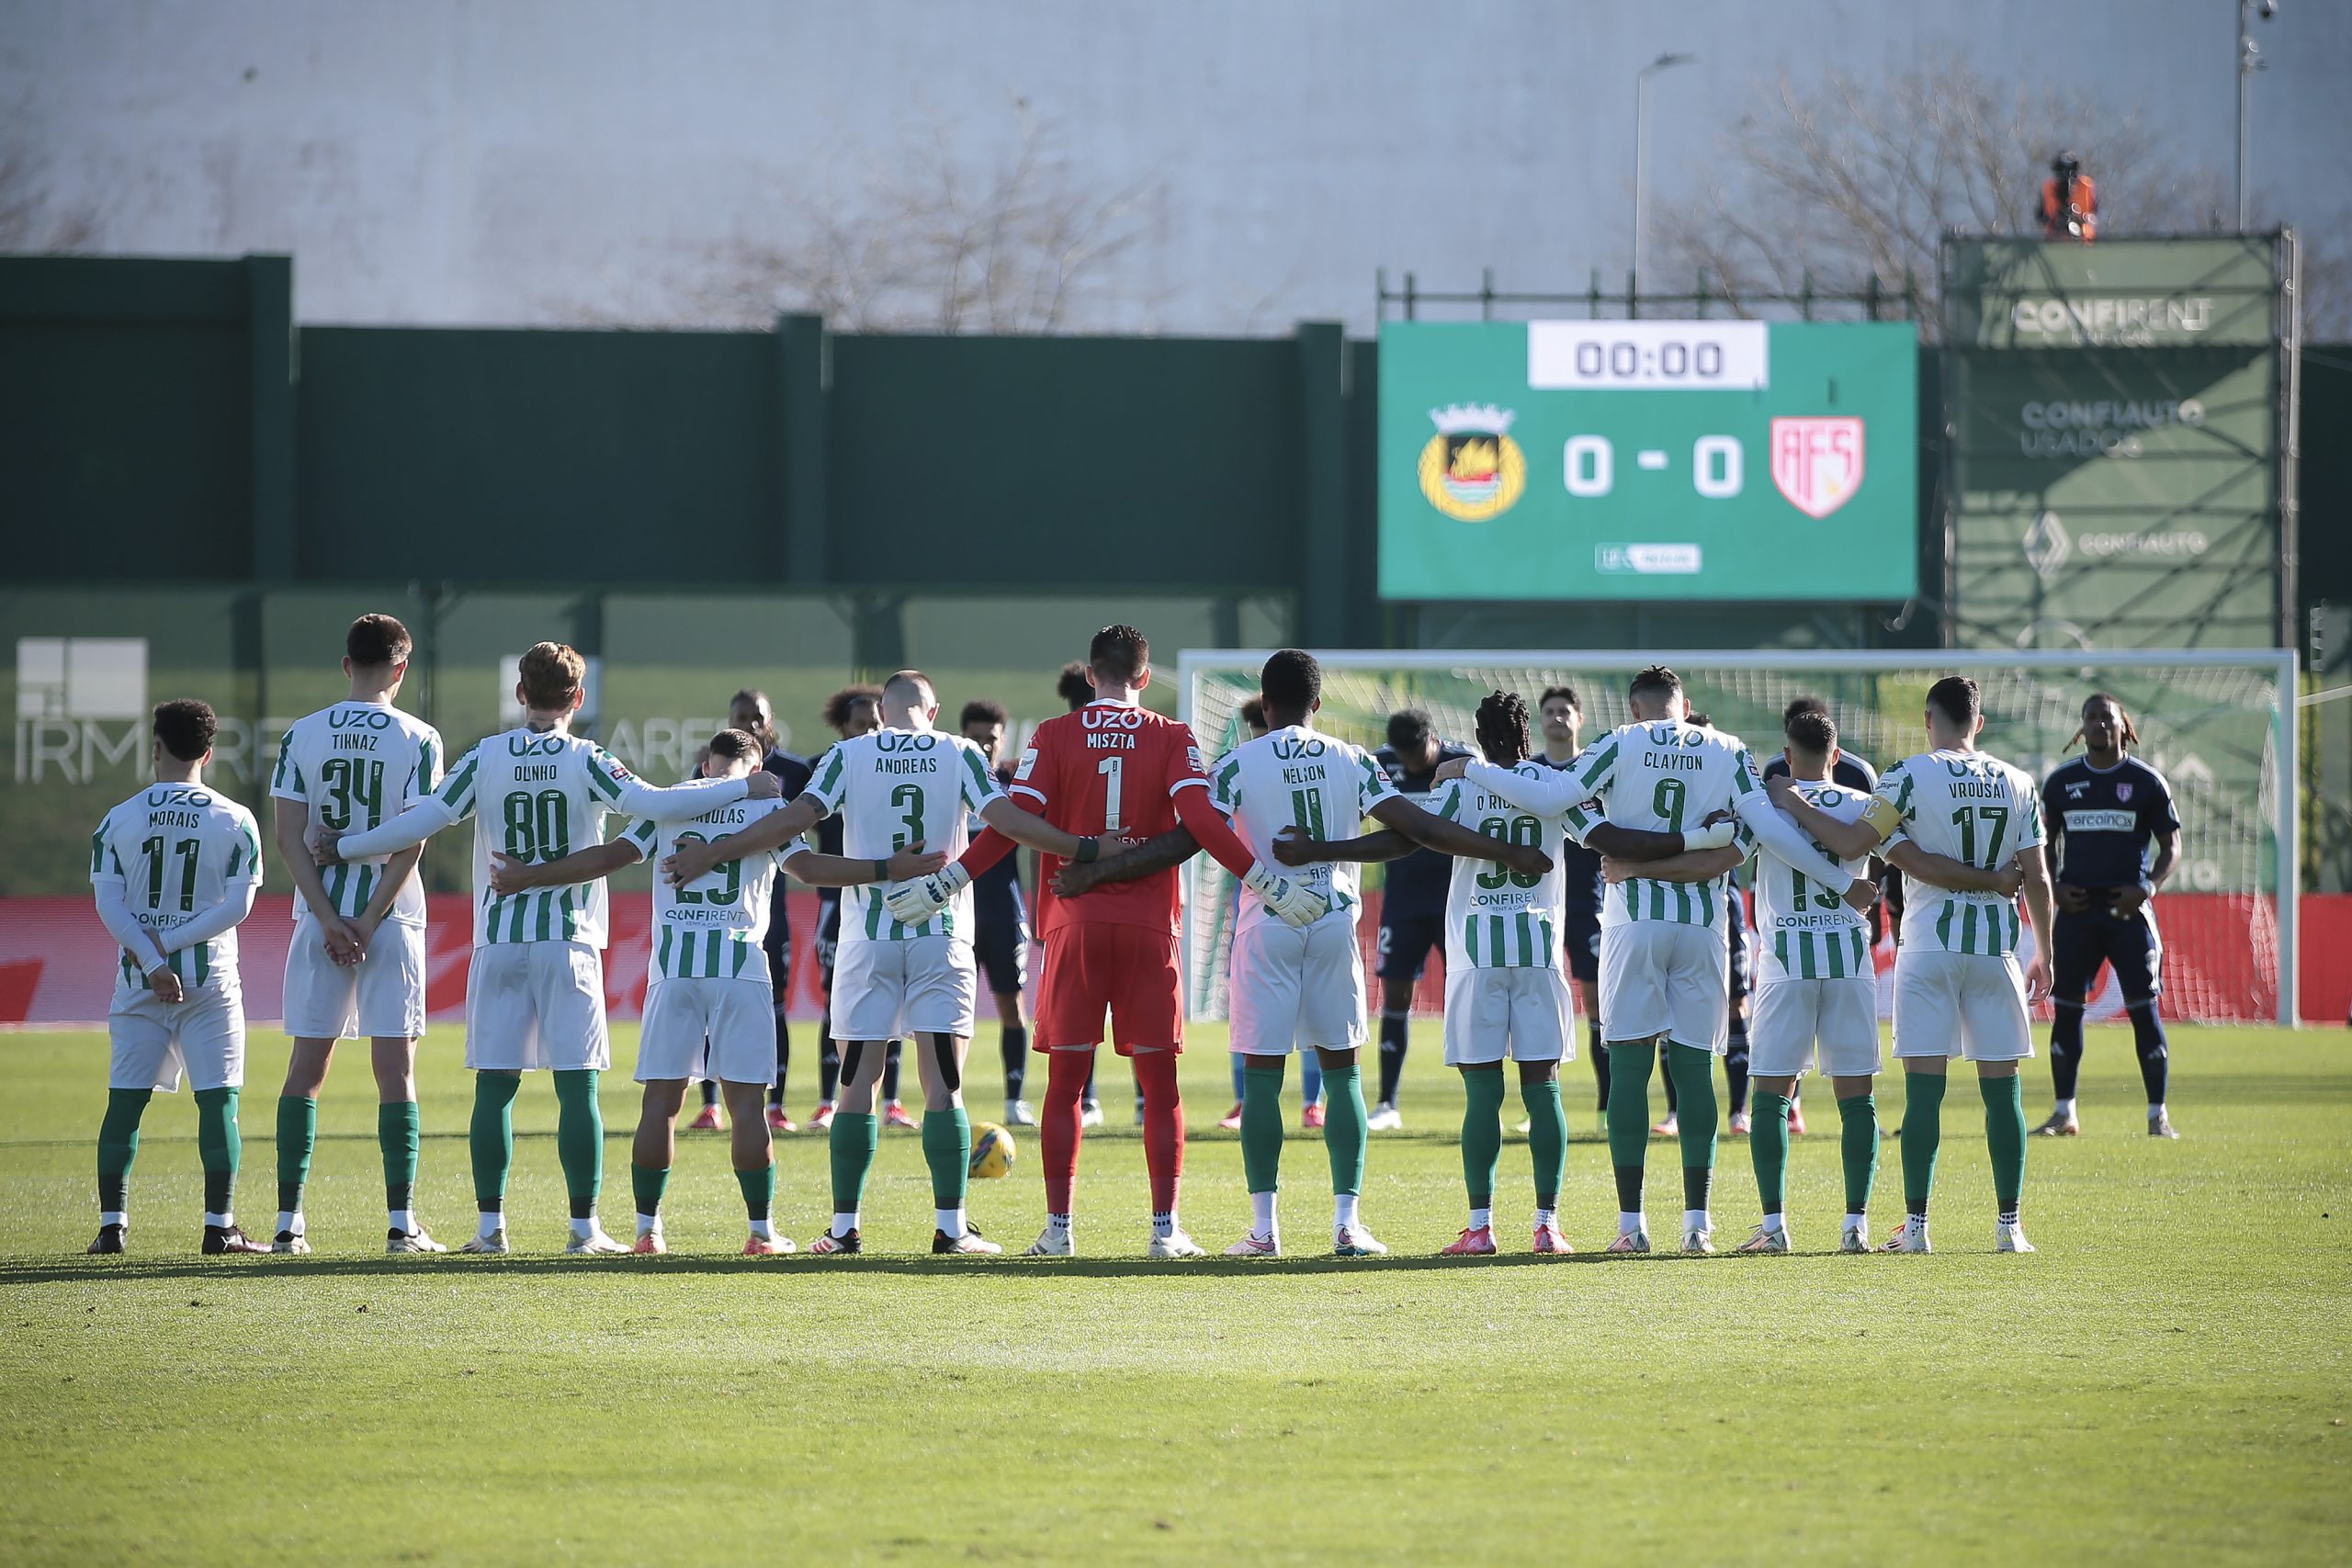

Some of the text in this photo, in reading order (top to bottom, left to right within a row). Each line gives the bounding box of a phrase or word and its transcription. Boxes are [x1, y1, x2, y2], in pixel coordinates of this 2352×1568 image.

[2012, 299, 2215, 332] CONFIRENT
[1576, 342, 1723, 378] 00:00
[2023, 400, 2205, 430] CONFIAUTO
[1563, 434, 1613, 498] 0
[1692, 434, 1745, 499] 0
[329, 710, 390, 729] UZO
[1081, 711, 1135, 729] UZO
[508, 736, 565, 757] UZO
[876, 734, 935, 753] UZO
[1087, 733, 1136, 749] MISZTA
[1272, 739, 1325, 760] UZO
[876, 758, 937, 774] ANDREAS
[1644, 751, 1702, 771] CLAYTON
[148, 790, 212, 807] UZO
[321, 758, 384, 832] 34
[1097, 755, 1123, 831] 1
[1949, 783, 2006, 799] VROUSAI
[1653, 778, 1686, 834] 9
[149, 810, 200, 829] MORAIS
[503, 789, 570, 863] 80
[890, 783, 925, 855] 3
[1951, 806, 2008, 873] 17
[141, 835, 200, 912] 11
